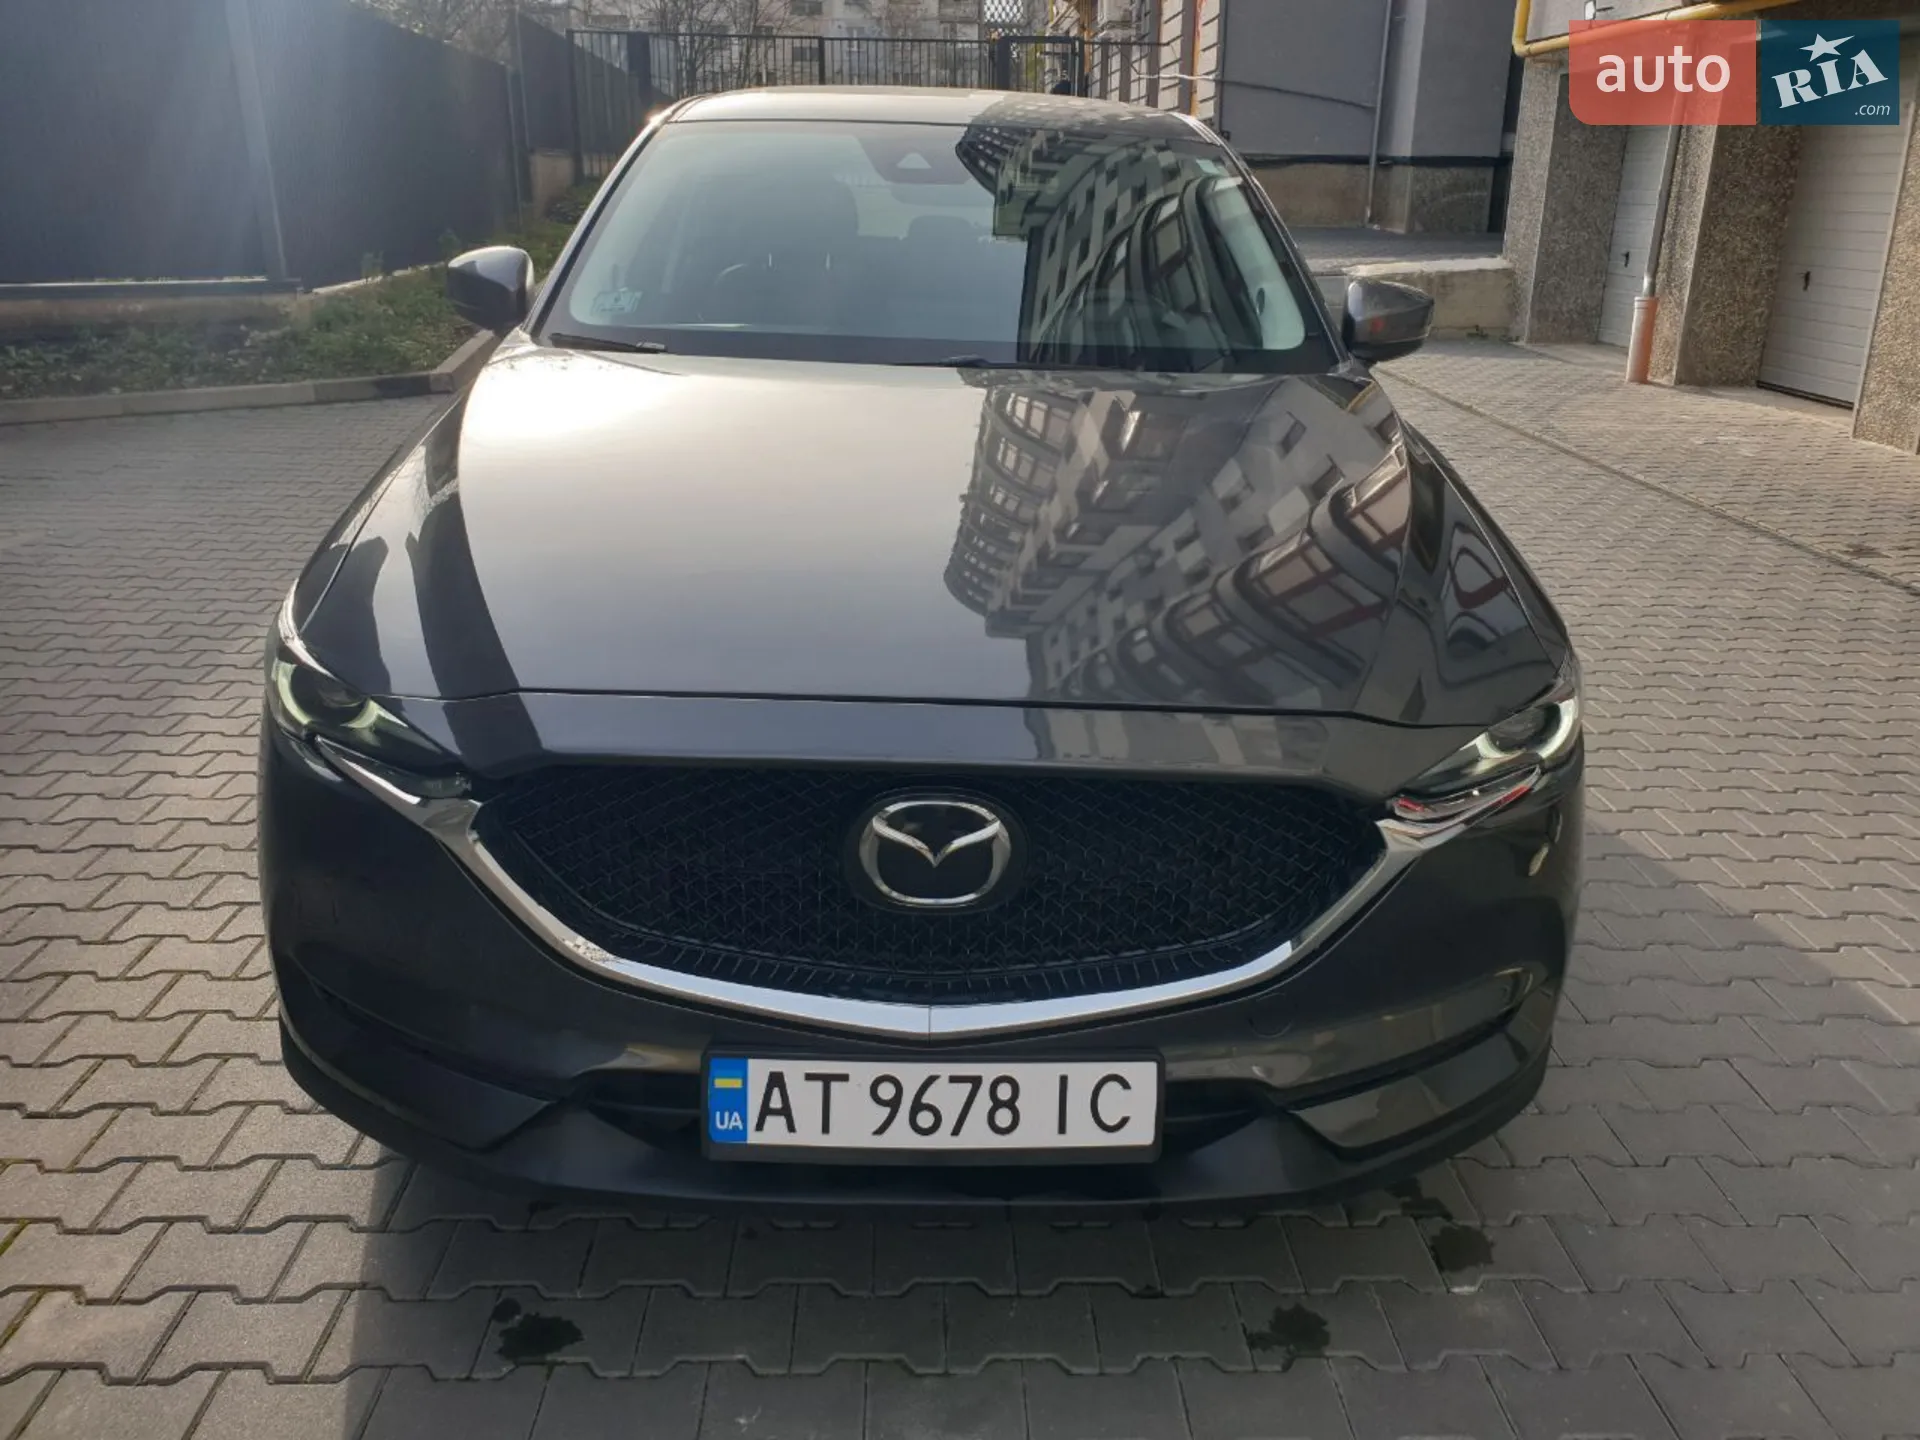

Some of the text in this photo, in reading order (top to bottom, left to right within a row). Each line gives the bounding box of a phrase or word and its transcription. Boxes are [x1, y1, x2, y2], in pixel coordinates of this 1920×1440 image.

[715, 1111, 744, 1131] UA
[755, 1071, 1132, 1137] AT 9678 IC
